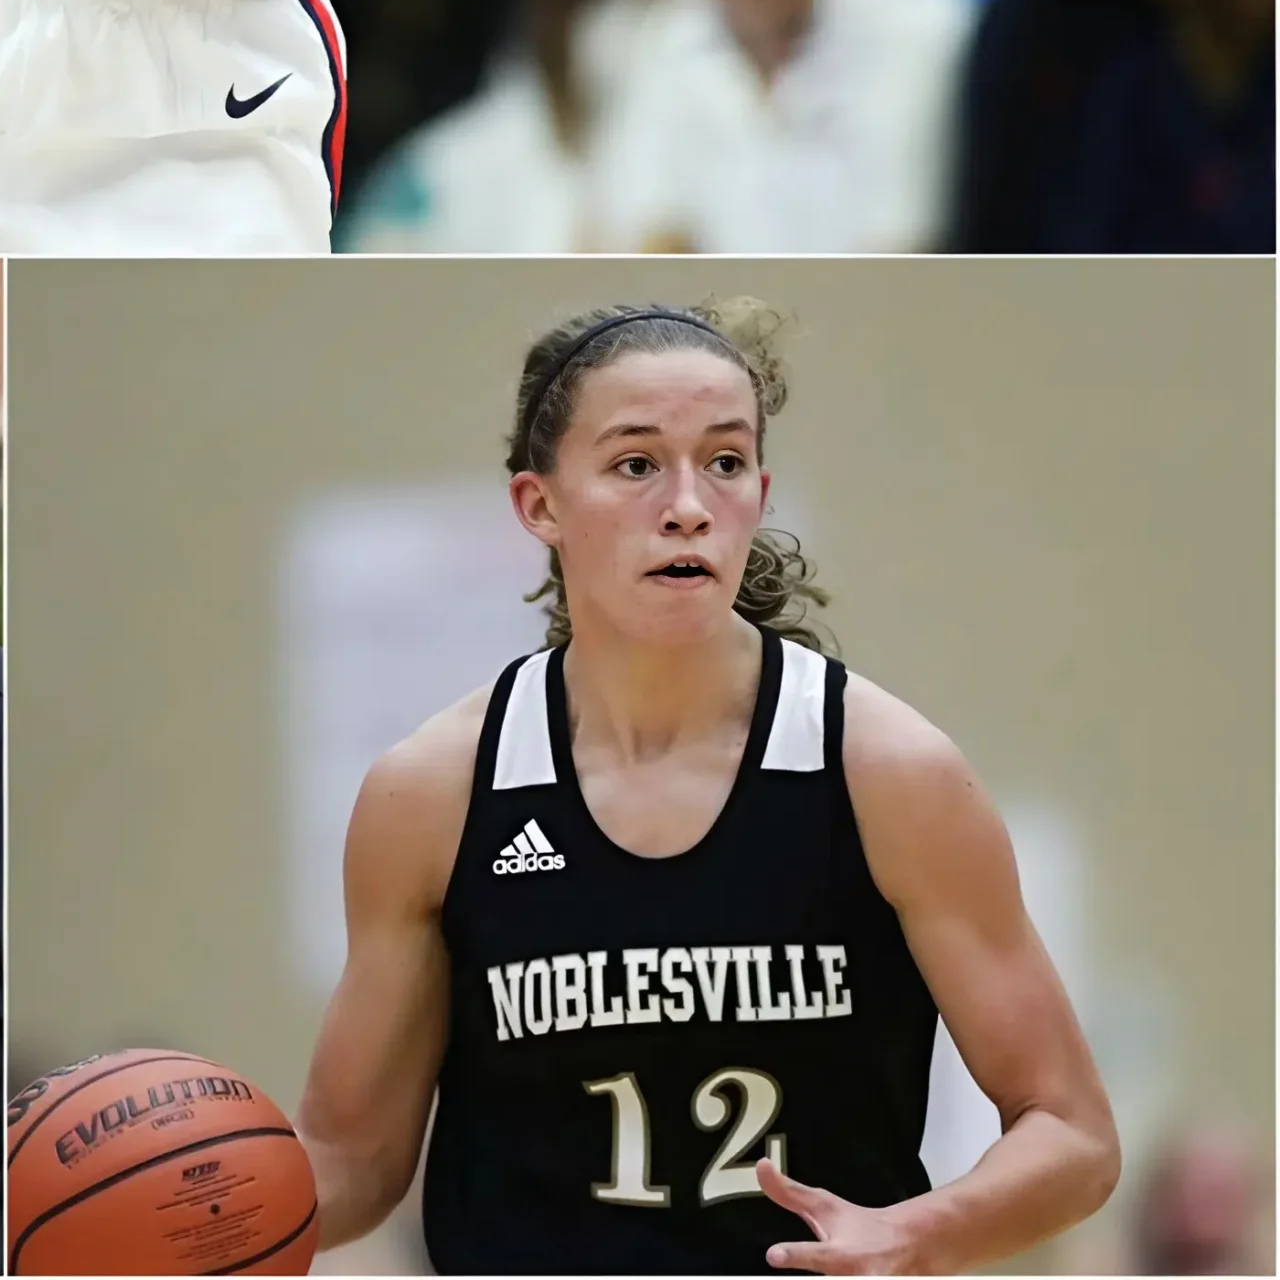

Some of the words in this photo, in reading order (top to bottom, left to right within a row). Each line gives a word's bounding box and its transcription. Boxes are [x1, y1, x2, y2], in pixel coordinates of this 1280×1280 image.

[492, 852, 566, 875] adidas
[487, 945, 852, 1041] NOBLESVILLE
[55, 1076, 253, 1165] EVOLUTION
[581, 1066, 788, 1208] 12
